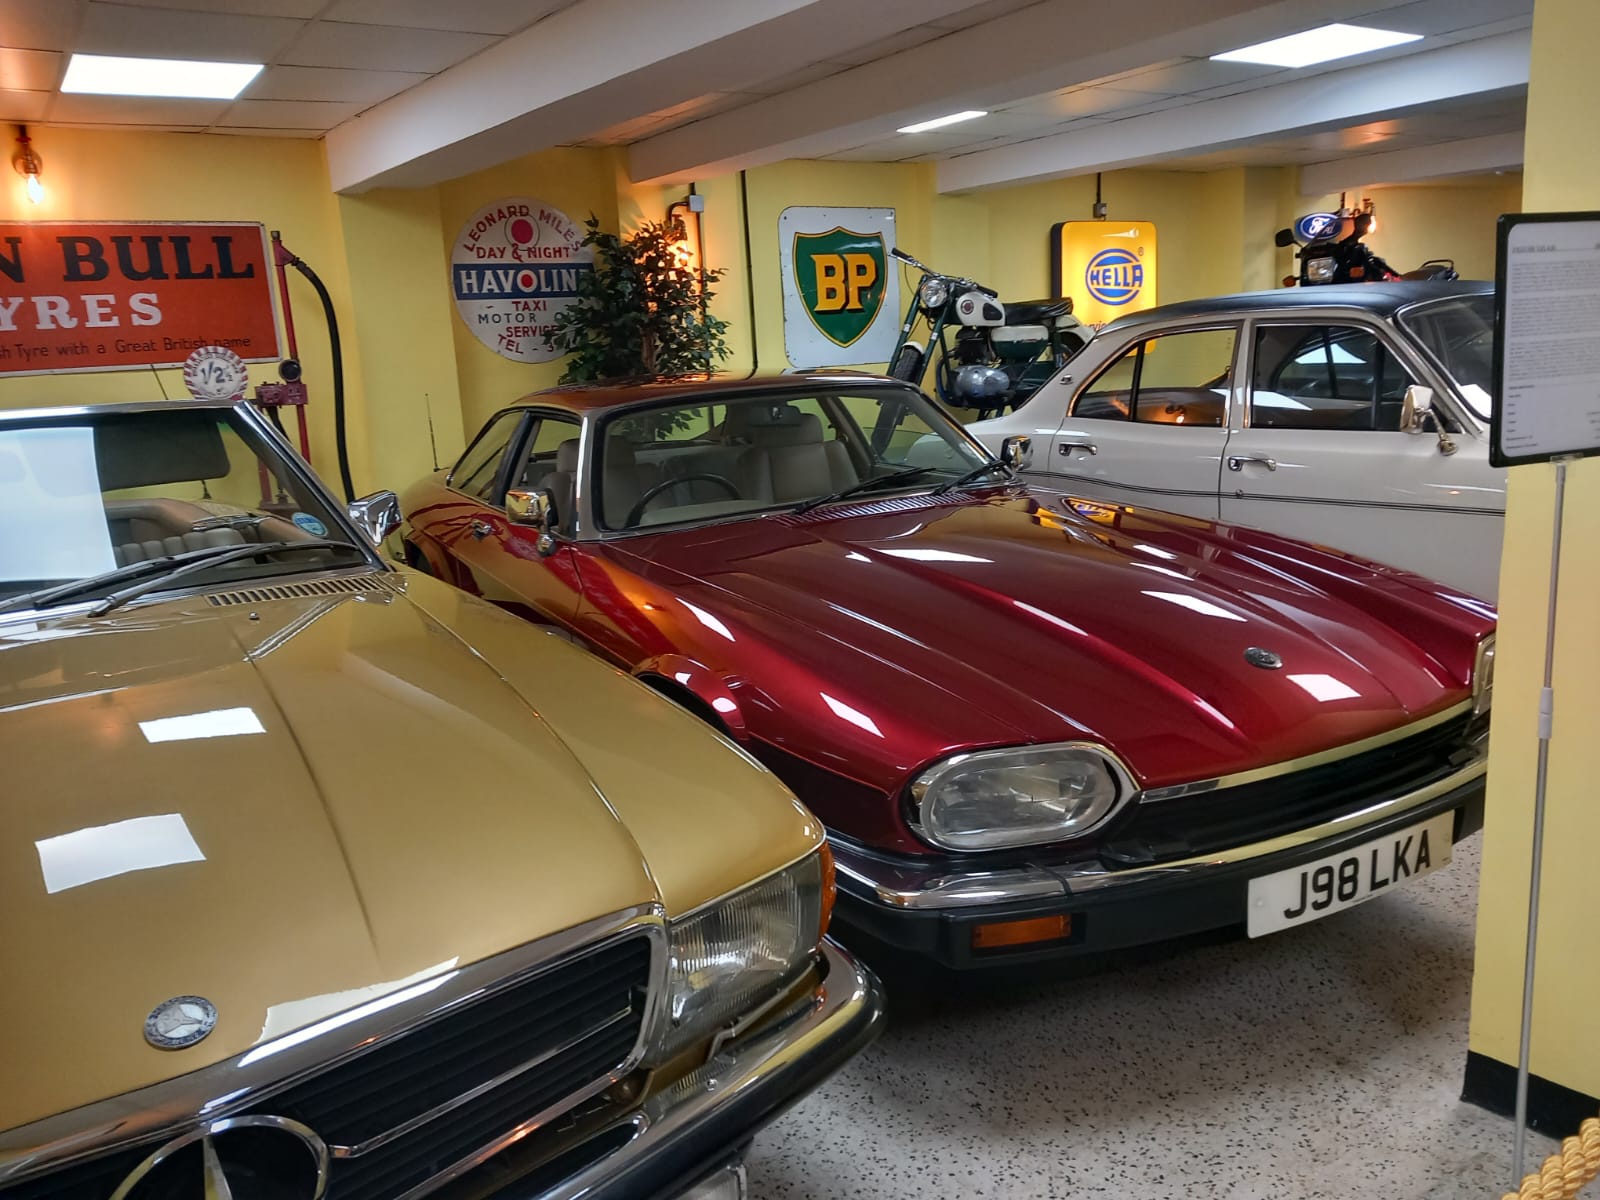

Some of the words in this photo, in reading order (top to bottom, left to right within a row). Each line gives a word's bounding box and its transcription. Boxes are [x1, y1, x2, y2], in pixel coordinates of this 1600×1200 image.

[464, 205, 530, 252] LEONARD
[56, 236, 255, 282] BULL
[476, 246, 506, 259] DAY
[511, 243, 524, 263] &
[527, 246, 570, 259] NIGHT
[459, 269, 589, 294] HAVOLIN
[810, 253, 877, 313] BP
[1090, 264, 1143, 288] HELLA
[0, 293, 163, 331] YRES
[478, 312, 537, 324] MOTOR
[512, 301, 547, 312] TAXI
[14, 343, 49, 362] Tyre
[56, 341, 89, 356] with
[97, 344, 106, 354] a
[114, 338, 158, 354] Great
[162, 335, 208, 351] British
[214, 337, 252, 349] name
[498, 334, 524, 354] TEL
[1283, 857, 1360, 920] J98
[1370, 829, 1431, 892] LKA
